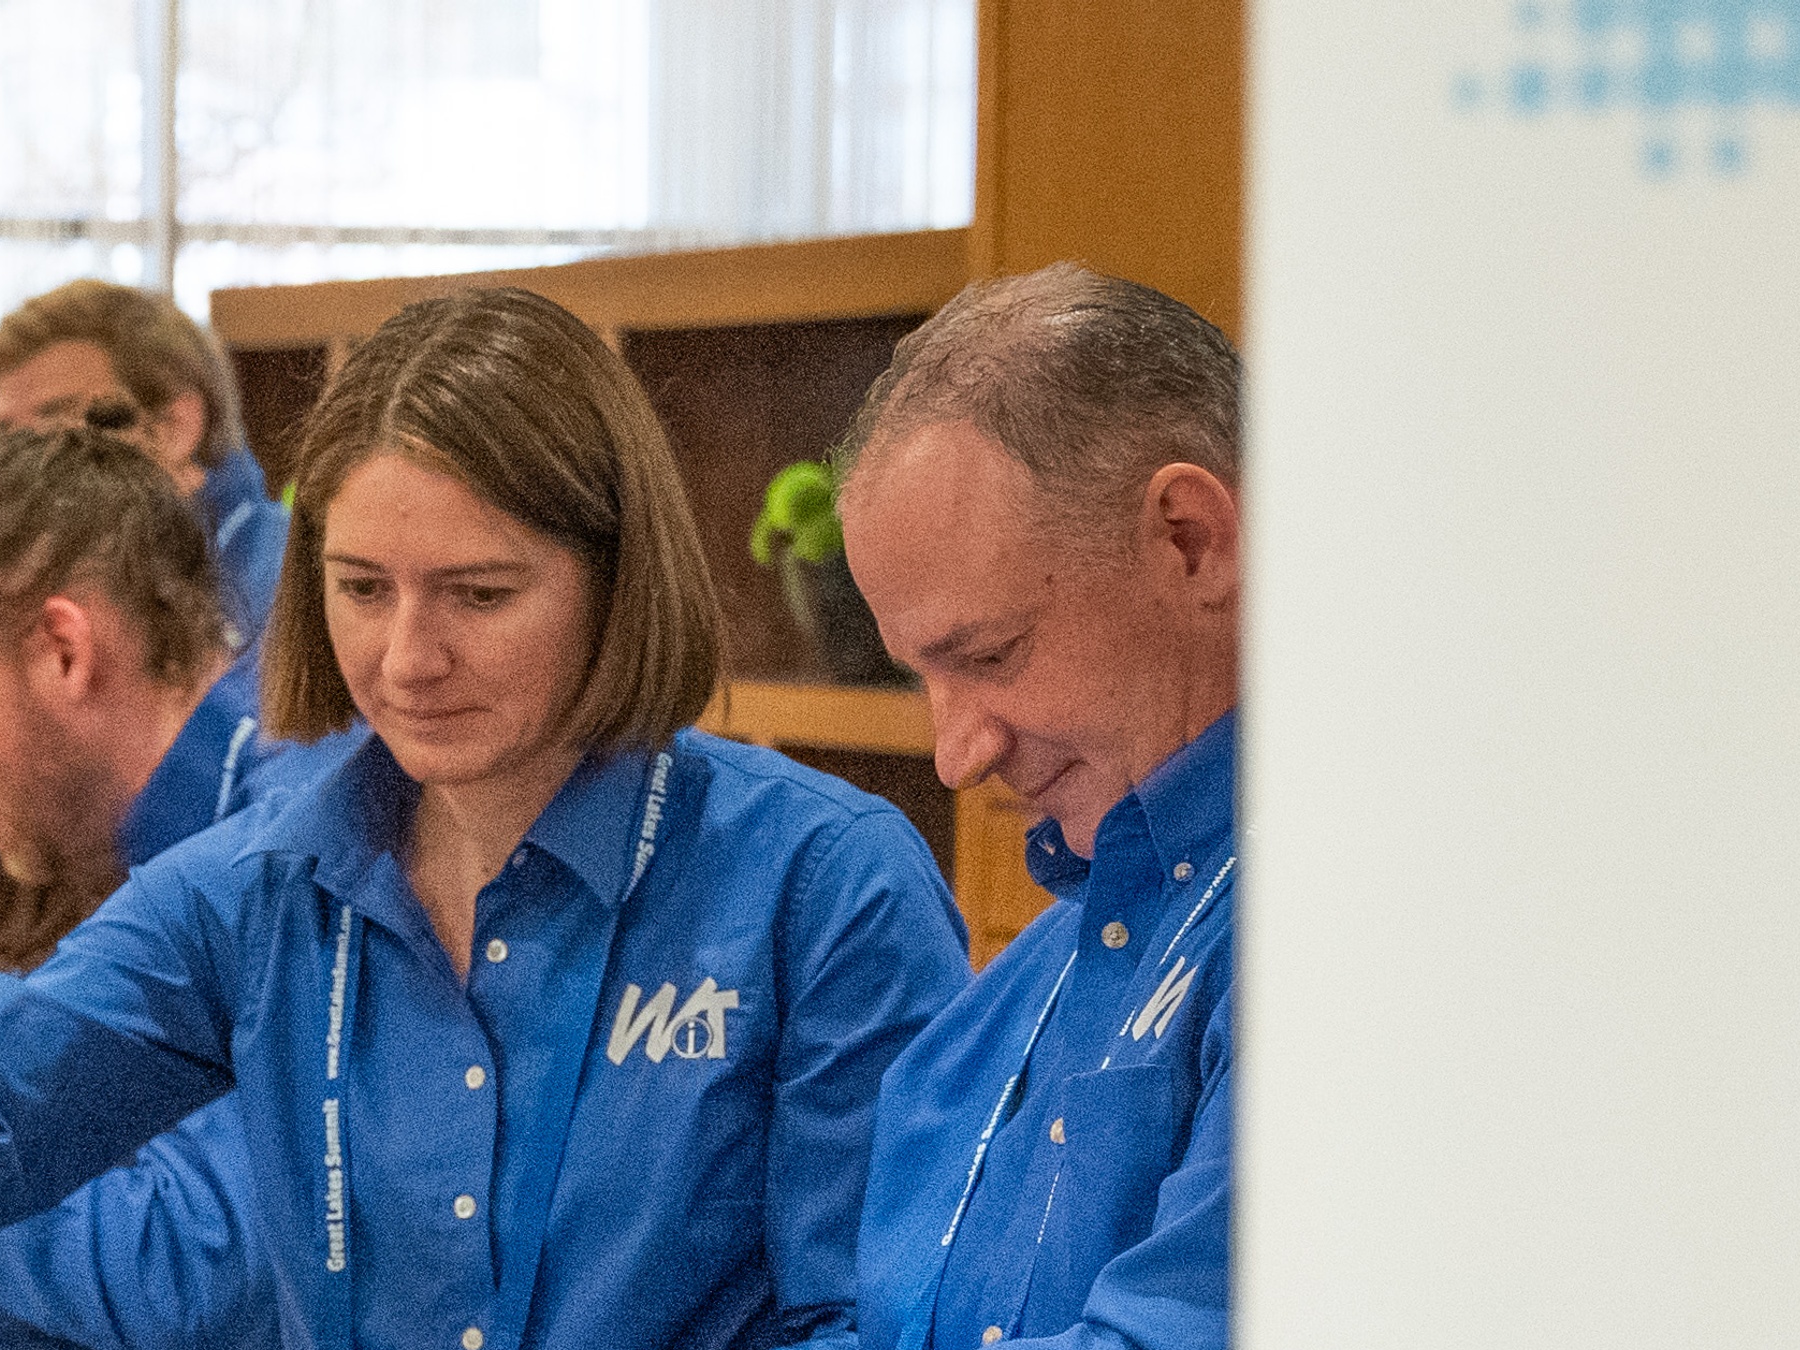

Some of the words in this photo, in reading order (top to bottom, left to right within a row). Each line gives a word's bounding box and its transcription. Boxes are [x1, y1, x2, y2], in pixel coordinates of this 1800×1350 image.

[649, 752, 673, 795] Great
[641, 794, 665, 840] Lakes
[321, 1098, 342, 1166] Summit
[325, 1167, 345, 1221] Lakes
[326, 1222, 346, 1272] Great
